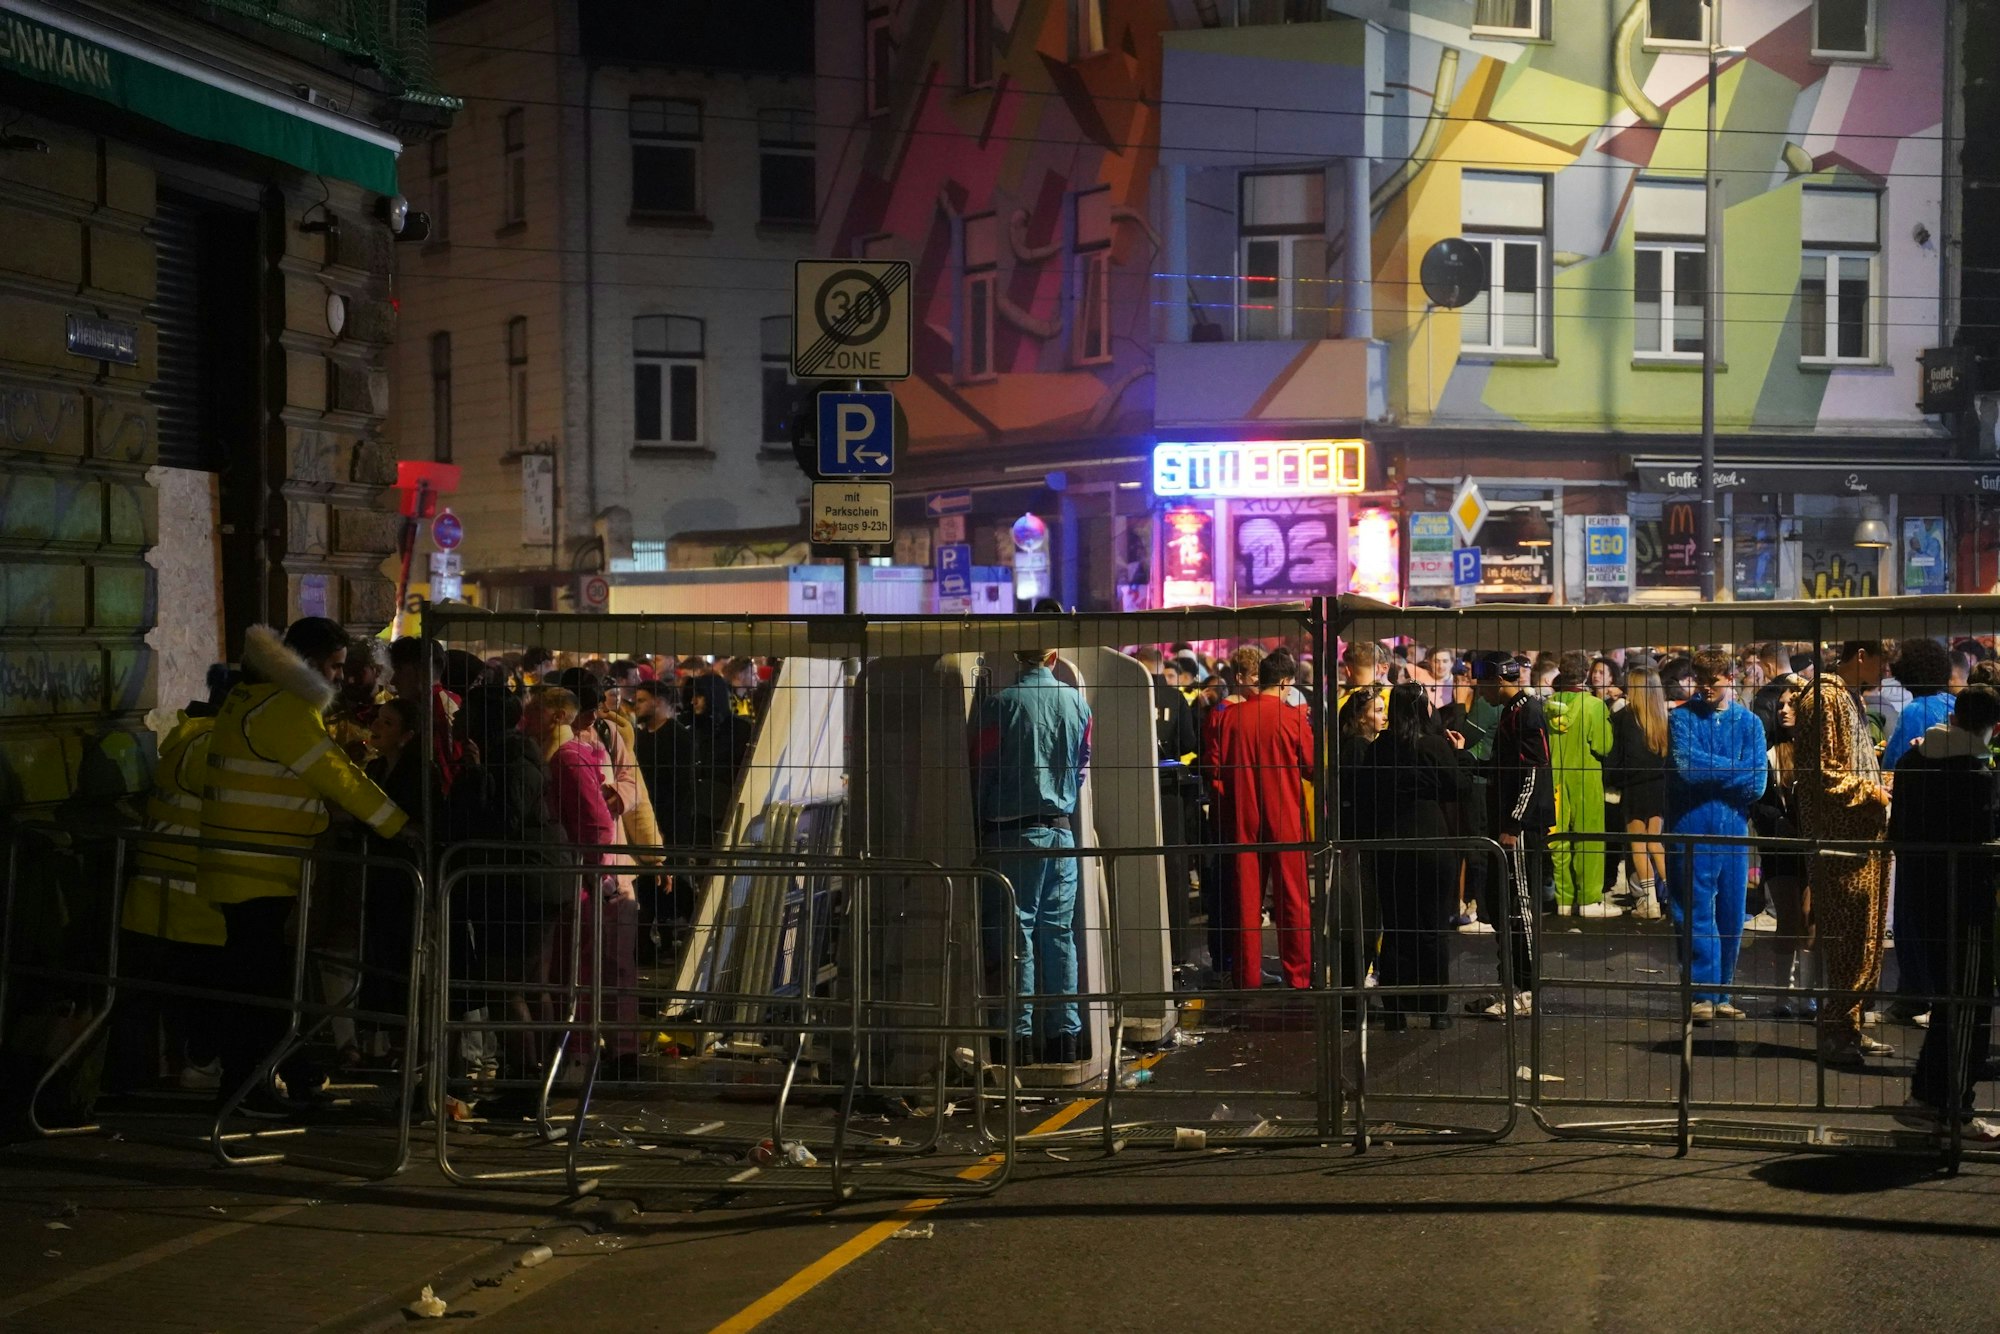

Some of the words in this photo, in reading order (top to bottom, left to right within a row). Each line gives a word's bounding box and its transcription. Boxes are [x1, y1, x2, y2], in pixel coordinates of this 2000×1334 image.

[832, 290, 873, 324] 30
[825, 352, 881, 369] ZONE
[837, 403, 876, 464] P
[1158, 446, 1363, 491] STIEFEL
[1667, 471, 1699, 488] Gaffe
[844, 492, 860, 502] mit
[825, 506, 879, 517] Parkschein
[861, 521, 888, 532] 9-23h
[1589, 534, 1624, 555] EGO
[942, 549, 957, 570] P
[1458, 552, 1475, 581] P
